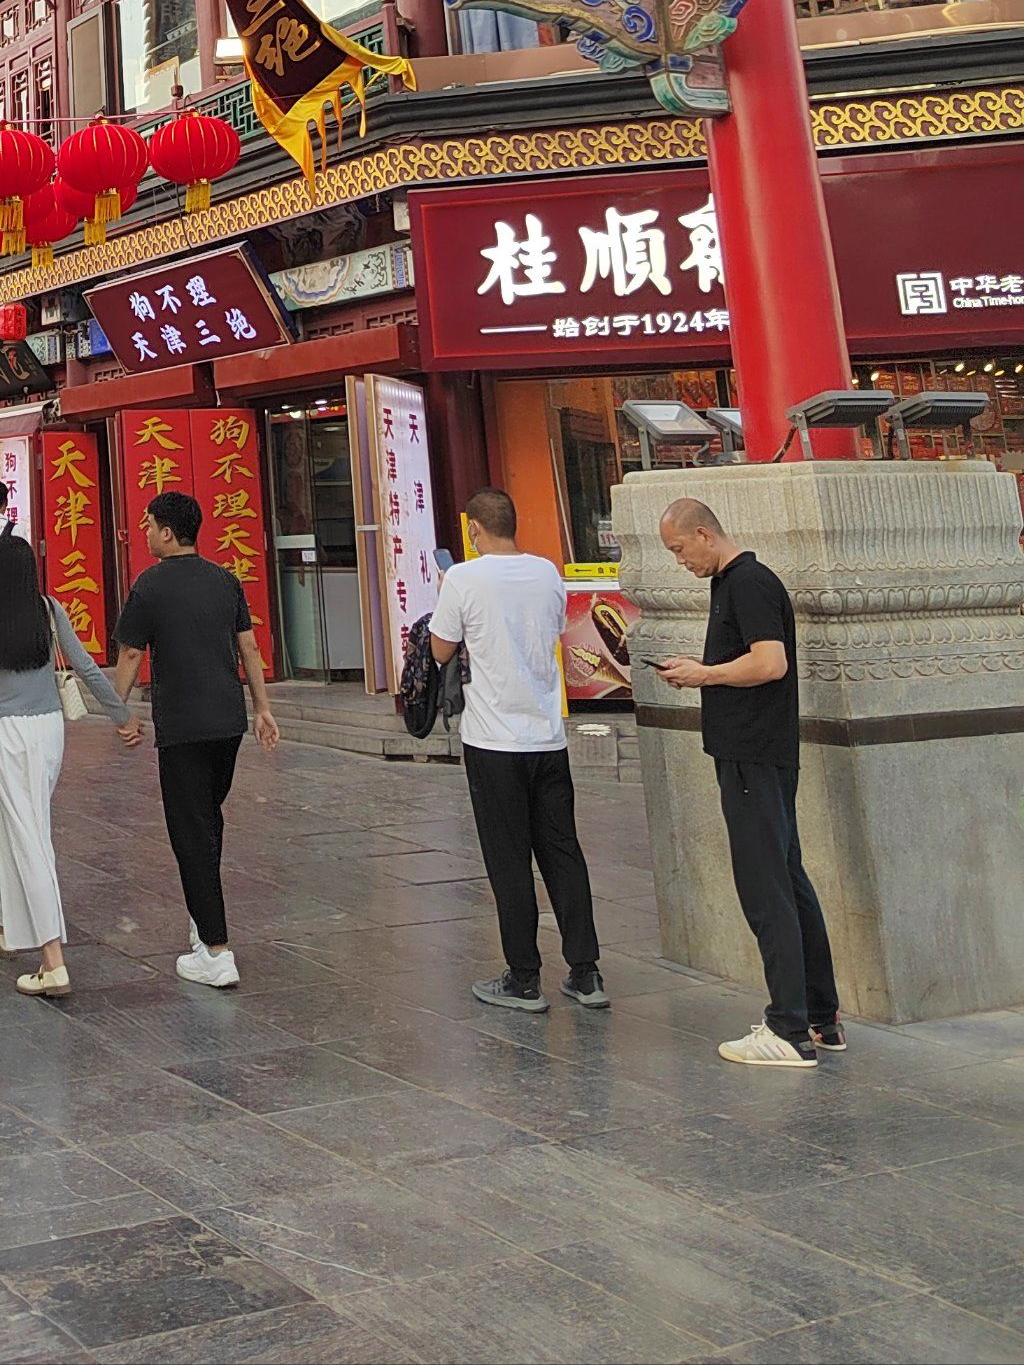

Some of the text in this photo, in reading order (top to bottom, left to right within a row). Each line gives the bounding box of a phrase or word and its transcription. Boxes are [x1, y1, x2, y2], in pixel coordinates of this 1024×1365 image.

[129, 275, 217, 323] 狗不理
[953, 297, 983, 308] China
[130, 307, 257, 363] 天津三绝
[4, 452, 19, 526] 狗不理
[132, 416, 185, 531] 天津
